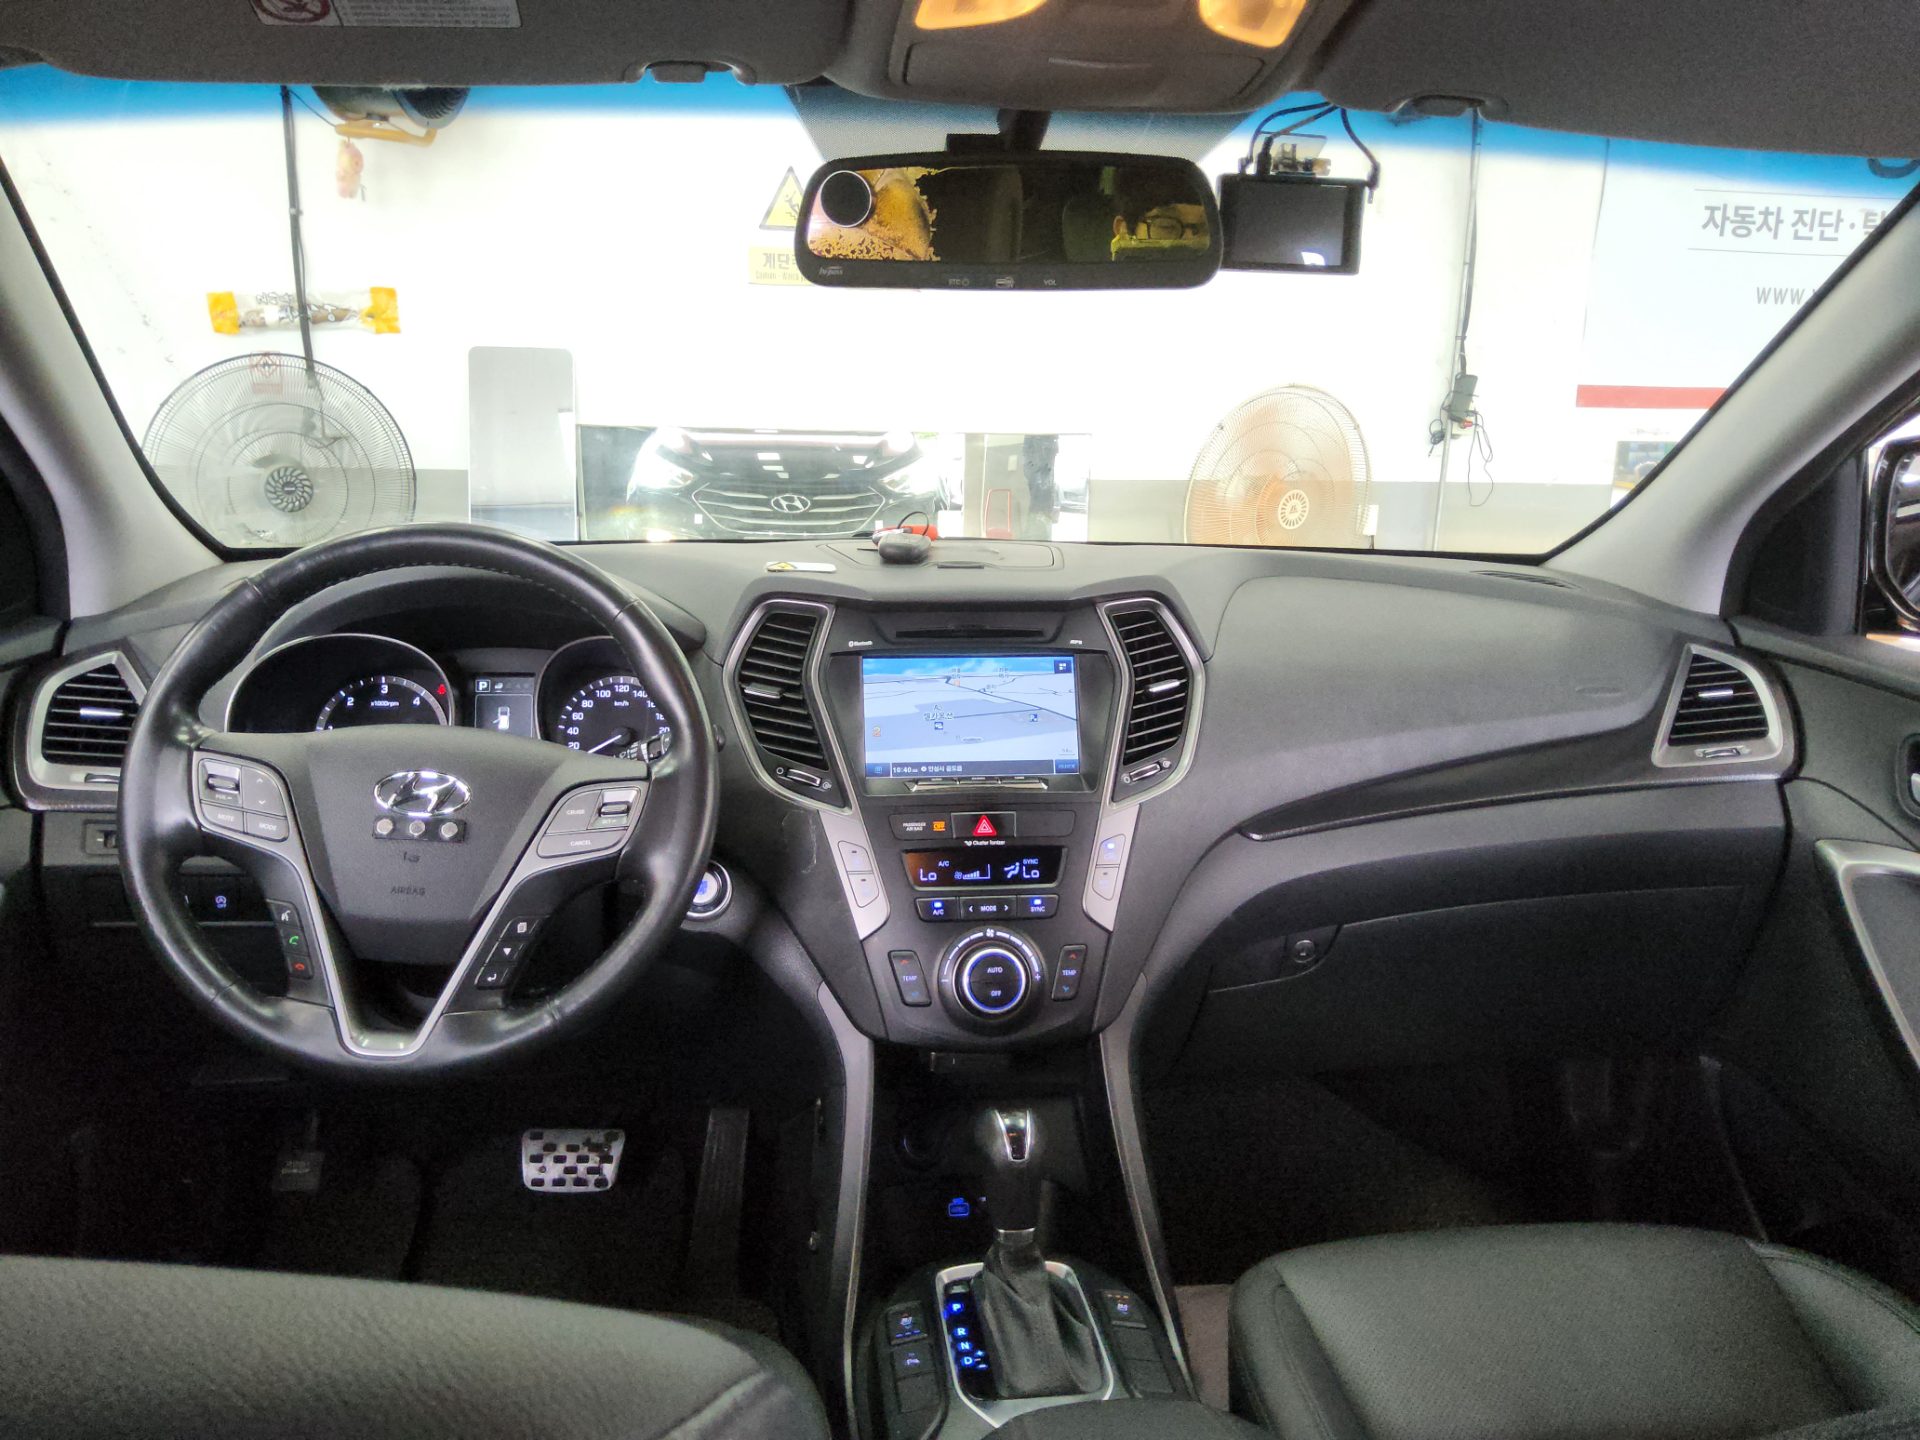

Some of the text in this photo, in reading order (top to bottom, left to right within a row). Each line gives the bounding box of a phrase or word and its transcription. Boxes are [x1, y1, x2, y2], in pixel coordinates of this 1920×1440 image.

[1702, 203, 1784, 240] 자동차
[762, 252, 797, 270] 계단
[381, 684, 389, 694] 3
[478, 681, 488, 691] P
[614, 685, 629, 693] 120
[596, 690, 611, 698] 100
[346, 697, 354, 706] 2
[413, 696, 421, 706] 4
[581, 700, 594, 708] 80
[572, 712, 584, 720] 60
[567, 727, 579, 735] 40
[568, 741, 580, 750] 20
[893, 766, 912, 774] 10:40
[259, 822, 277, 832] MODE
[1062, 969, 1077, 977] TEMP
[952, 1303, 961, 1311] P
[957, 1327, 966, 1336] R
[960, 1341, 970, 1350] N
[964, 1356, 973, 1365] D
